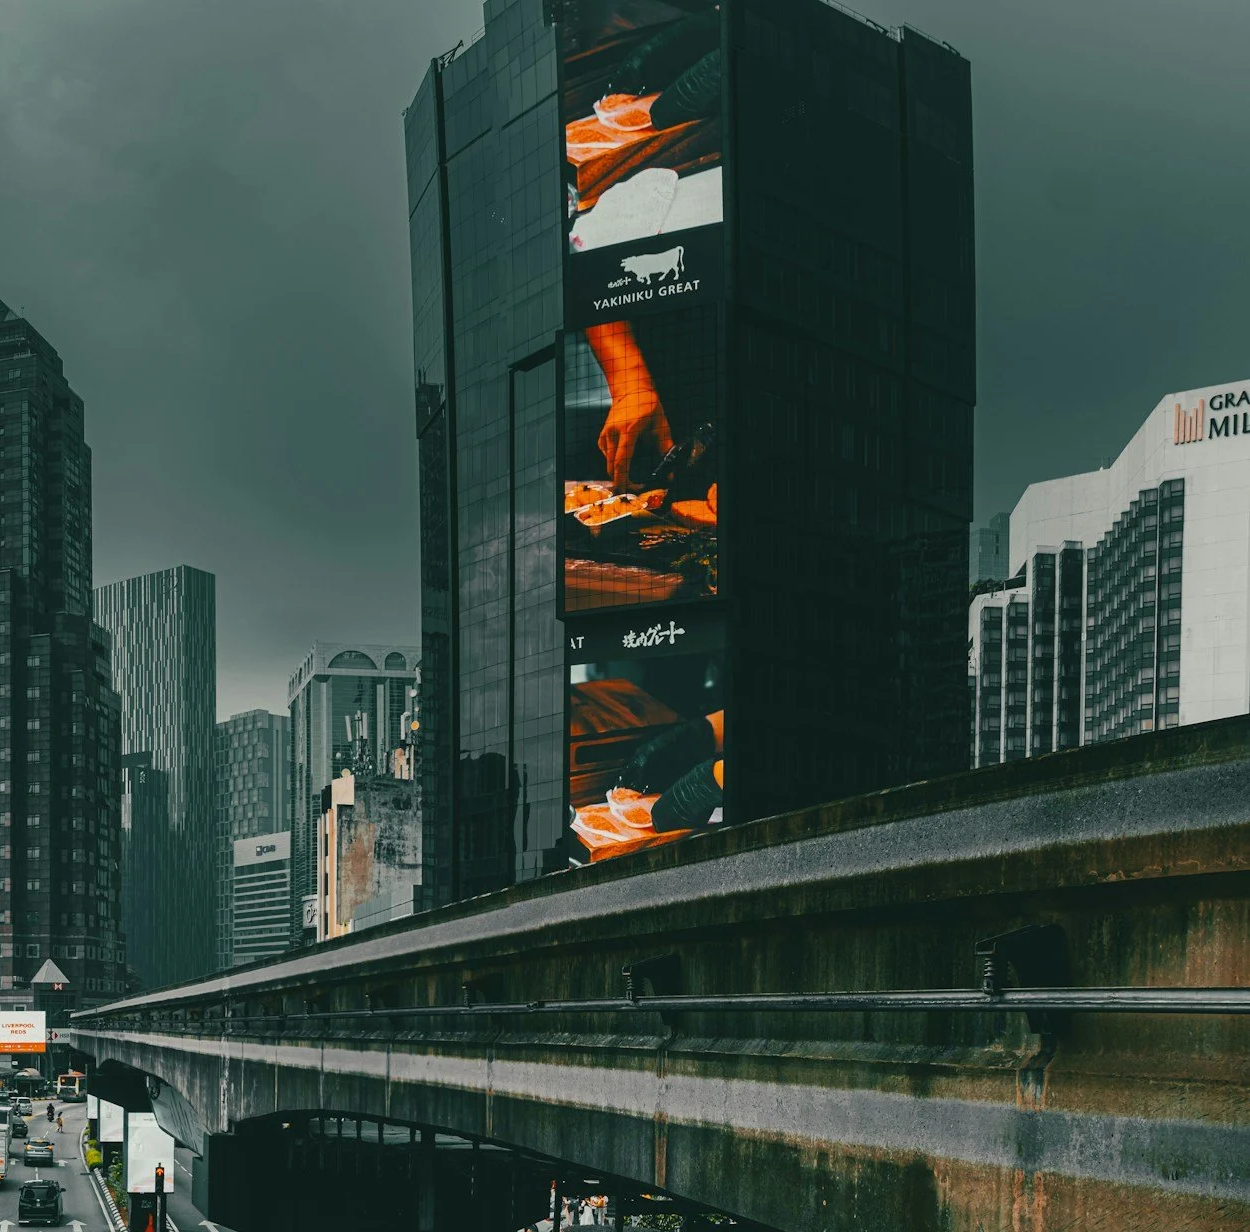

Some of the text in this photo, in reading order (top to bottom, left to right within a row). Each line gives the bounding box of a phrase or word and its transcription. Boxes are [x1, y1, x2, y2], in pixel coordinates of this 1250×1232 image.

[594, 280, 700, 310] YAKINIKU GREAT
[1209, 391, 1250, 410] GRA
